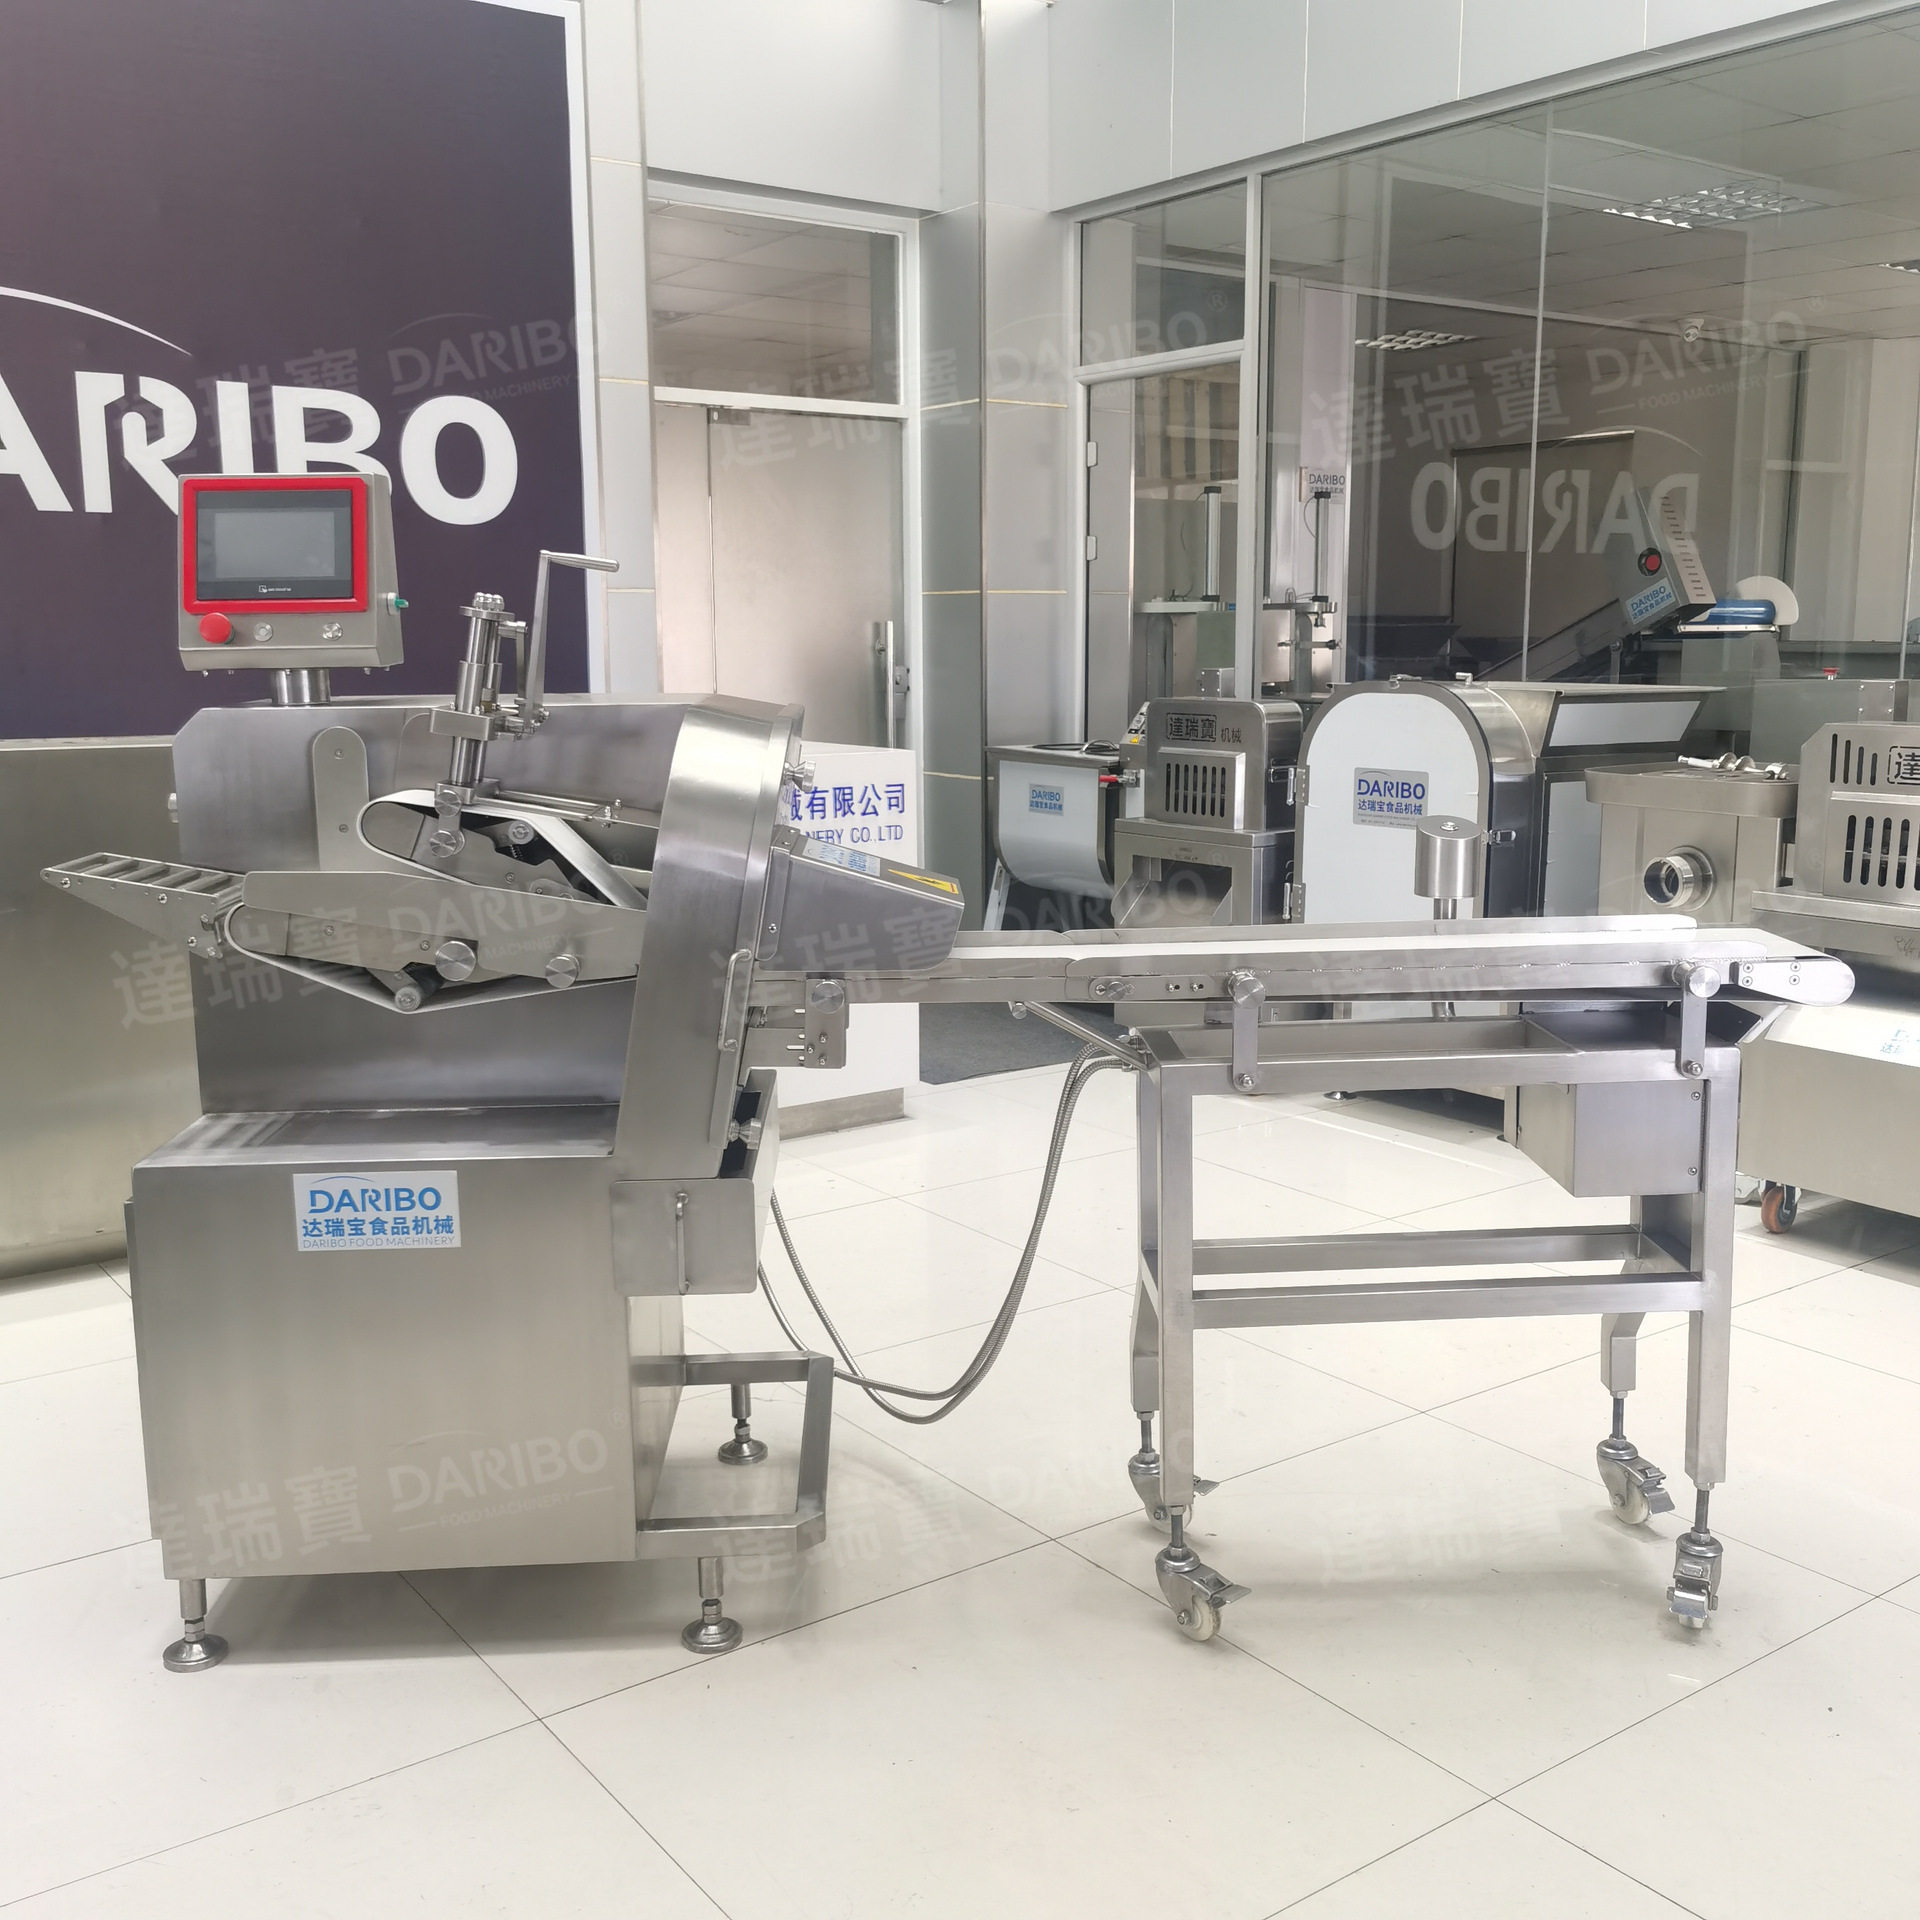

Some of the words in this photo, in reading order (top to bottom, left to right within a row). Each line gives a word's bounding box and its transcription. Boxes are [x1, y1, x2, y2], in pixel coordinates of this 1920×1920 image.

[1308, 474, 1346, 486] DARIBO
[1631, 585, 1666, 611] DARIBO
[1169, 717, 1216, 740] 達瑞寶
[1221, 727, 1242, 743] 机械
[1031, 789, 1061, 802] DARIBO
[1357, 778, 1426, 800] DARIBO
[1357, 799, 1423, 816] 达瑞宝食品机械
[308, 1186, 442, 1214] DARIBO
[302, 1215, 455, 1238] 达瑞宝食品机械
[303, 1237, 347, 1249] DARIBO
[350, 1236, 384, 1248] FOOD
[386, 1235, 456, 1247] MACHINERY
